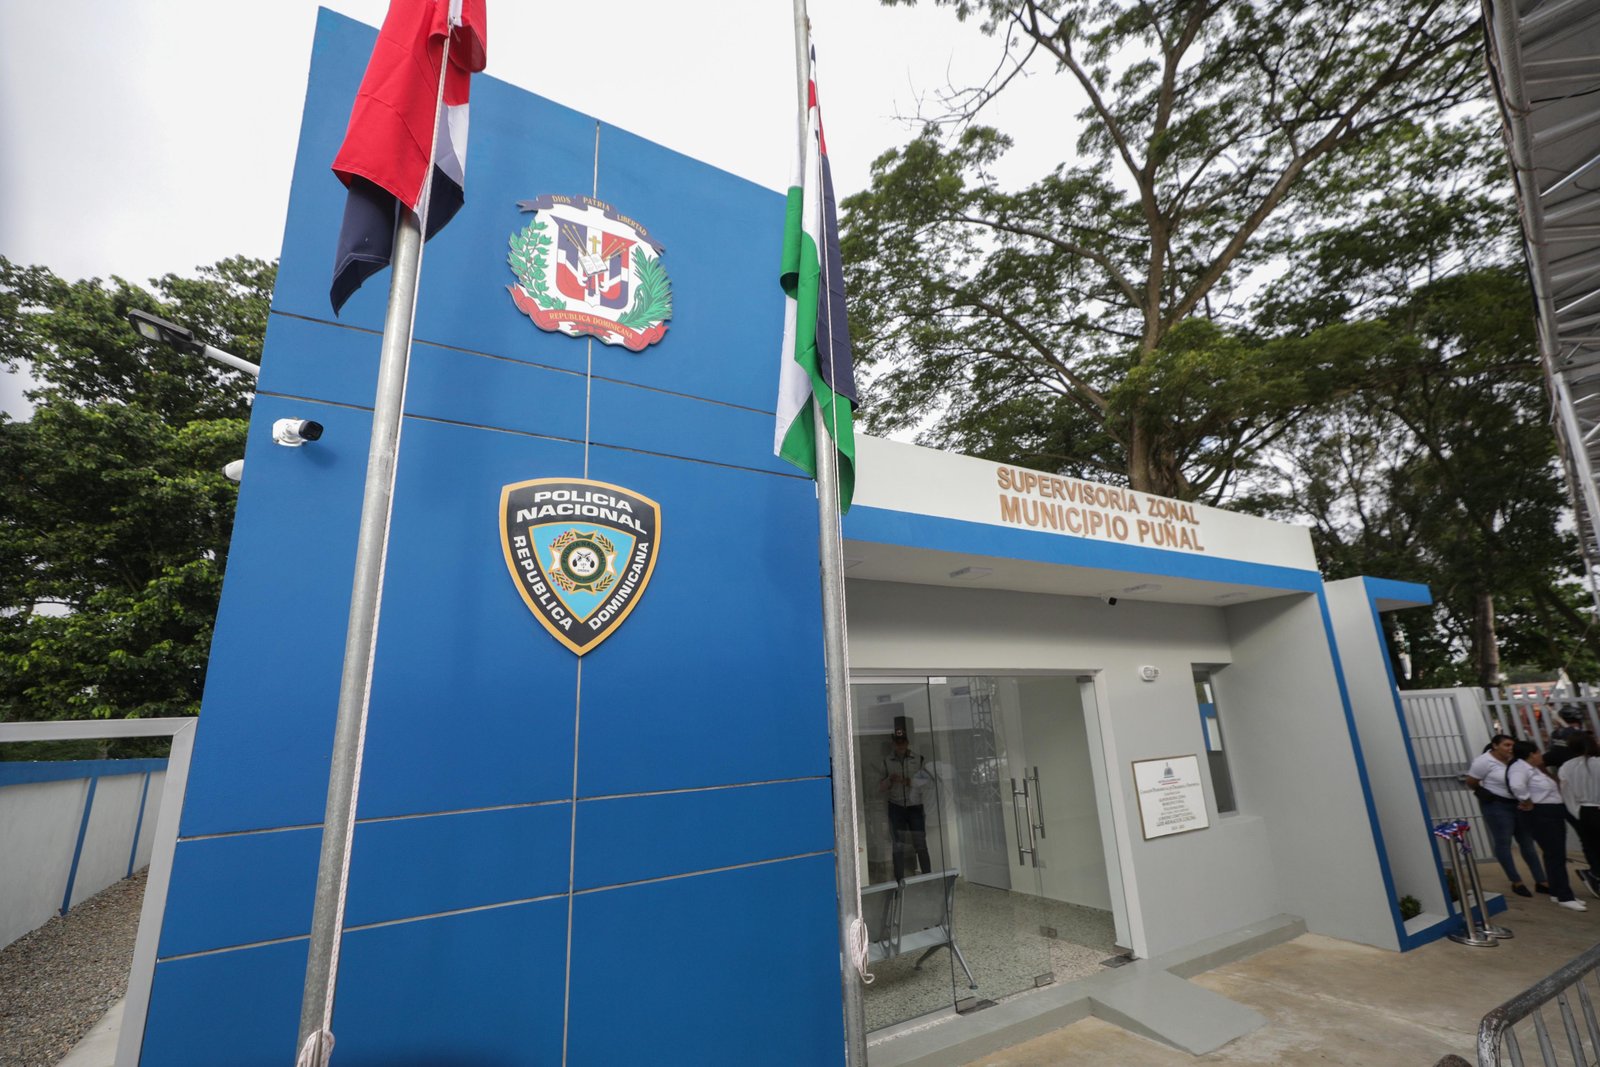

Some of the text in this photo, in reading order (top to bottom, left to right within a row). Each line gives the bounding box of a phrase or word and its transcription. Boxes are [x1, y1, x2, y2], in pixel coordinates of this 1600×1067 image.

[552, 195, 647, 236] DIOS PATRIA LIBERTAD
[549, 312, 633, 339] REPUBLICA DOMINICANA
[534, 490, 633, 513] POLICIA
[1146, 497, 1200, 525] ZONAL
[516, 503, 647, 535] NACIONAL
[999, 494, 1205, 552] MUNICIPIO PUÑAL
[513, 535, 649, 631] REPUBLICA DOMINICANA
